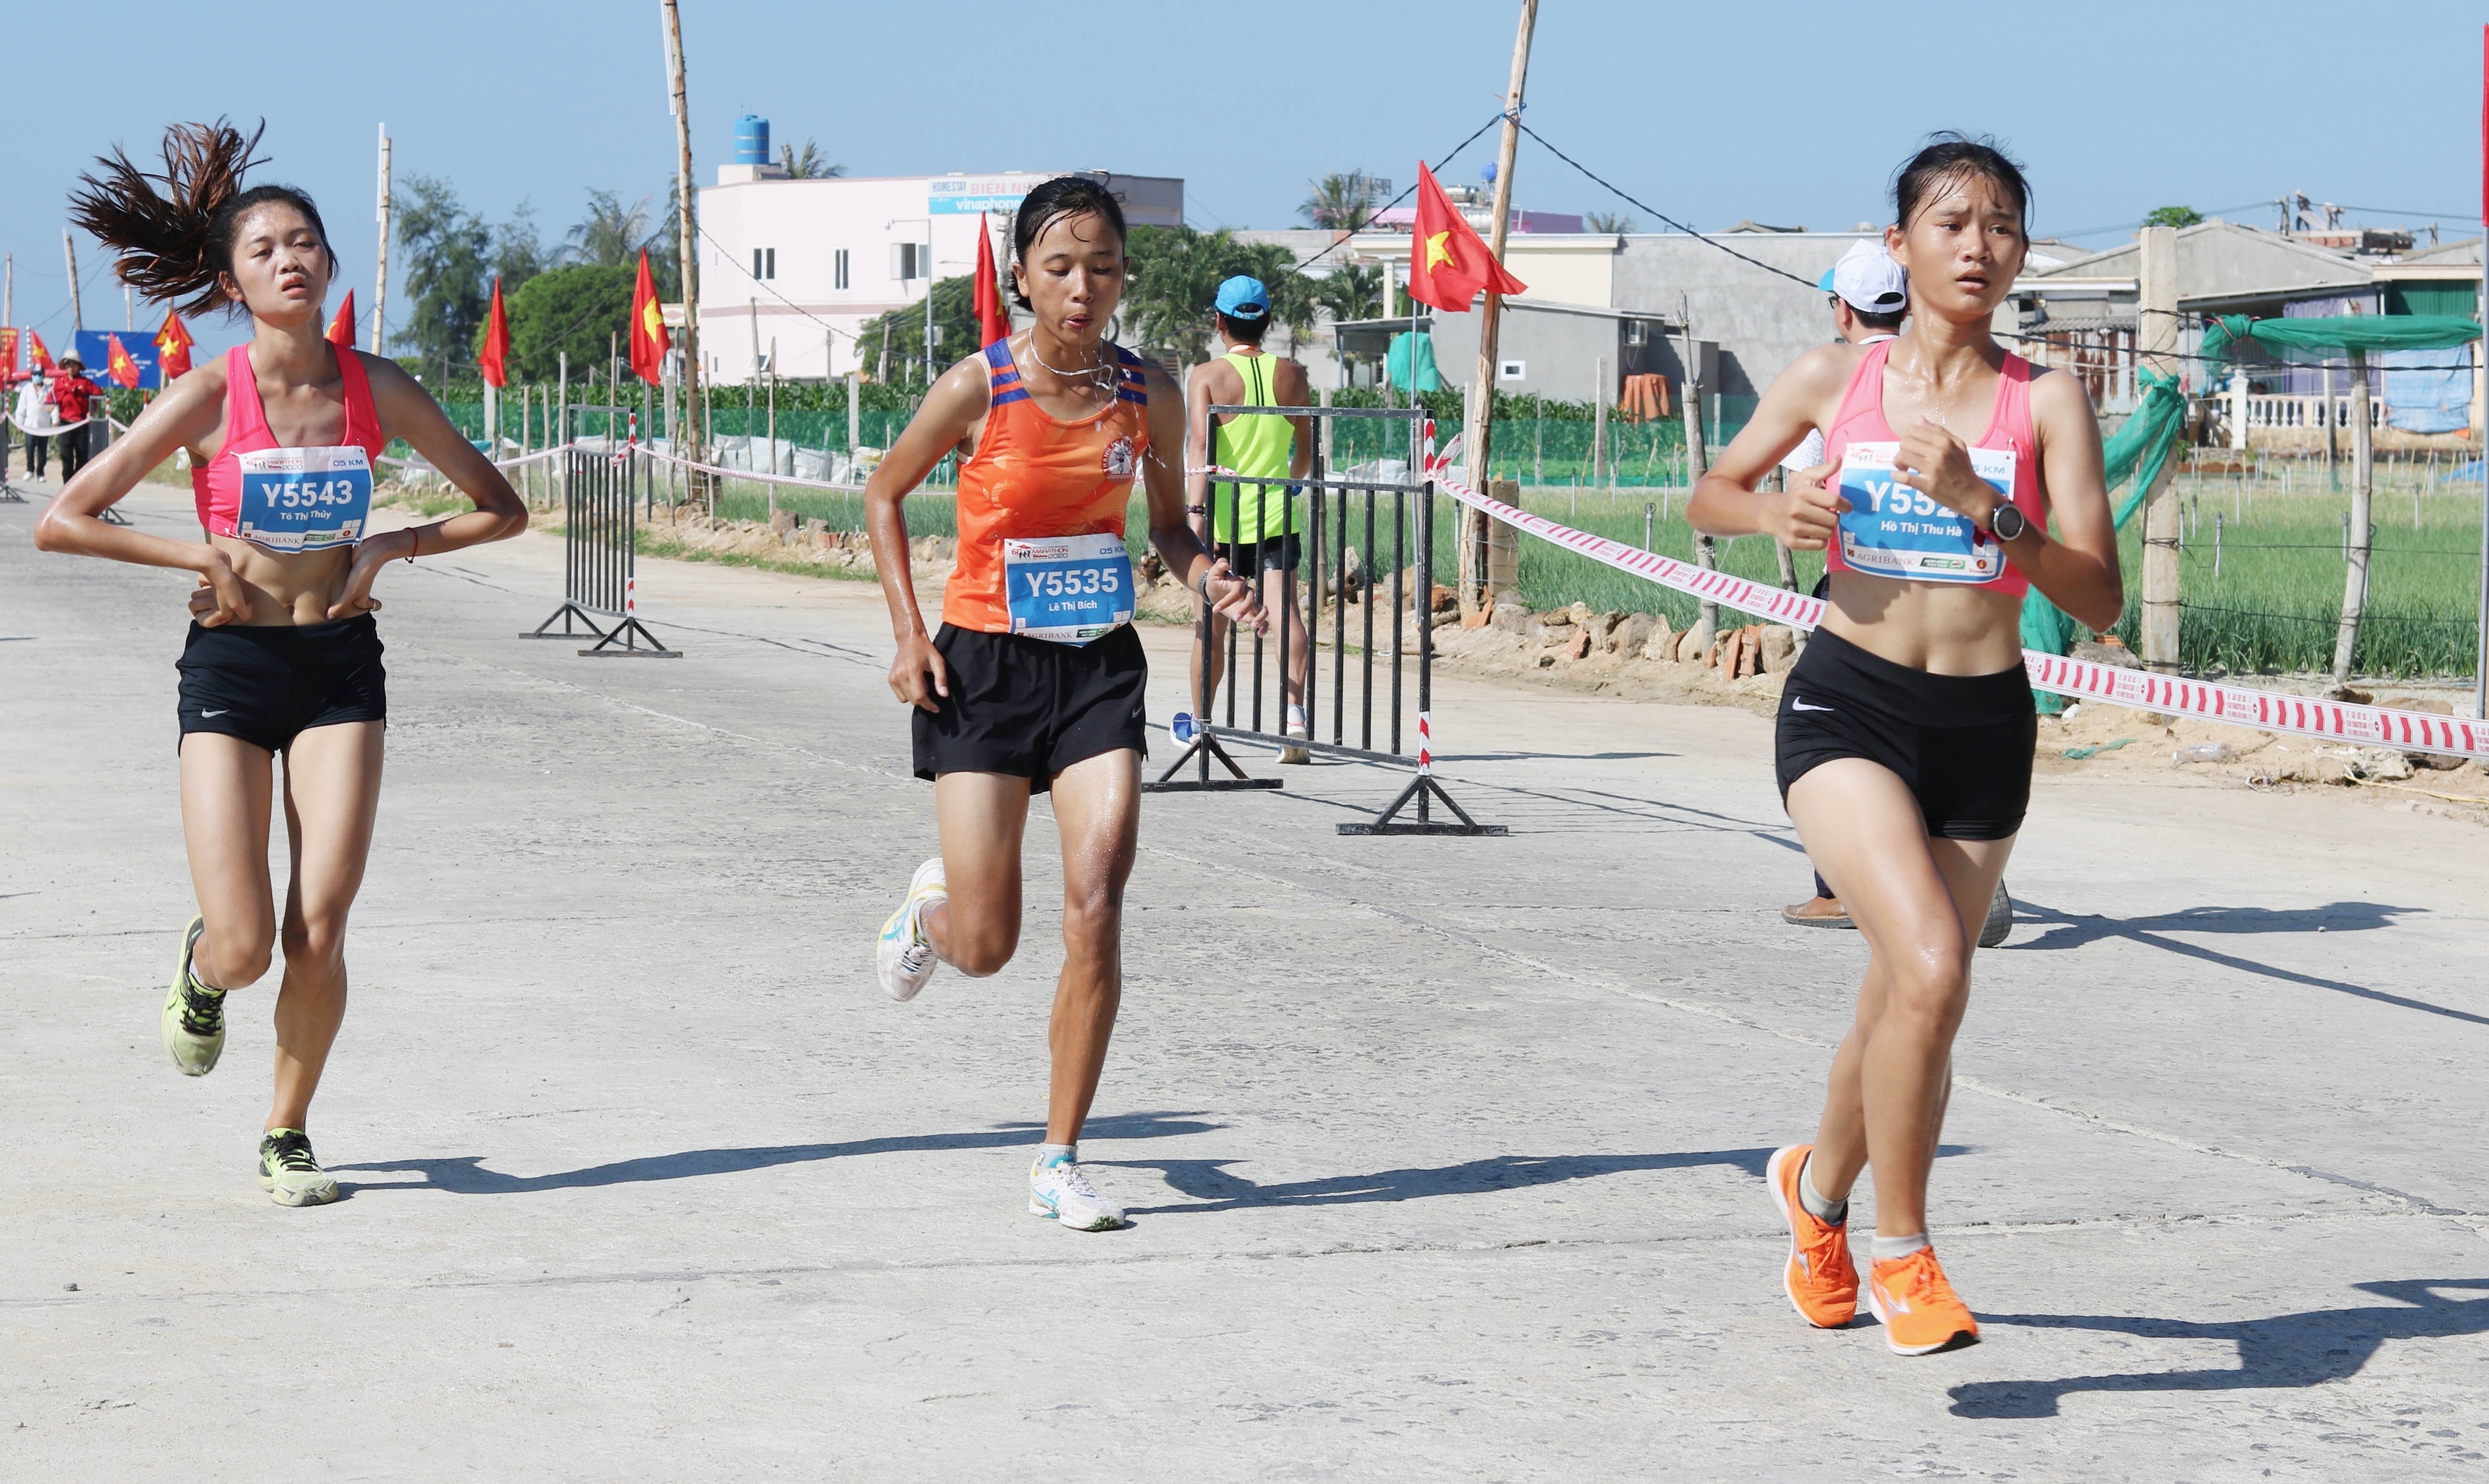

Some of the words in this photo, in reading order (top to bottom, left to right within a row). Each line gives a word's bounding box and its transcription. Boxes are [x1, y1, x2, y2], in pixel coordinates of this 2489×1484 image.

[932, 181, 967, 192] HOMESTAY
[956, 197, 1021, 211] vinaphone
[1984, 465, 2005, 474] KM
[261, 480, 353, 507] Y5543
[1864, 480, 1970, 519] Y55
[295, 511, 308, 521] Thị
[1900, 522, 1919, 536] Thị
[1922, 523, 1944, 536] Thu
[255, 535, 300, 544] AGRIBANK
[1856, 553, 1914, 566] AGRIBANK
[1025, 568, 1118, 597] Y5535
[1049, 602, 1059, 612] Lê
[1061, 601, 1076, 612] Thị
[1077, 600, 1097, 610] Bích
